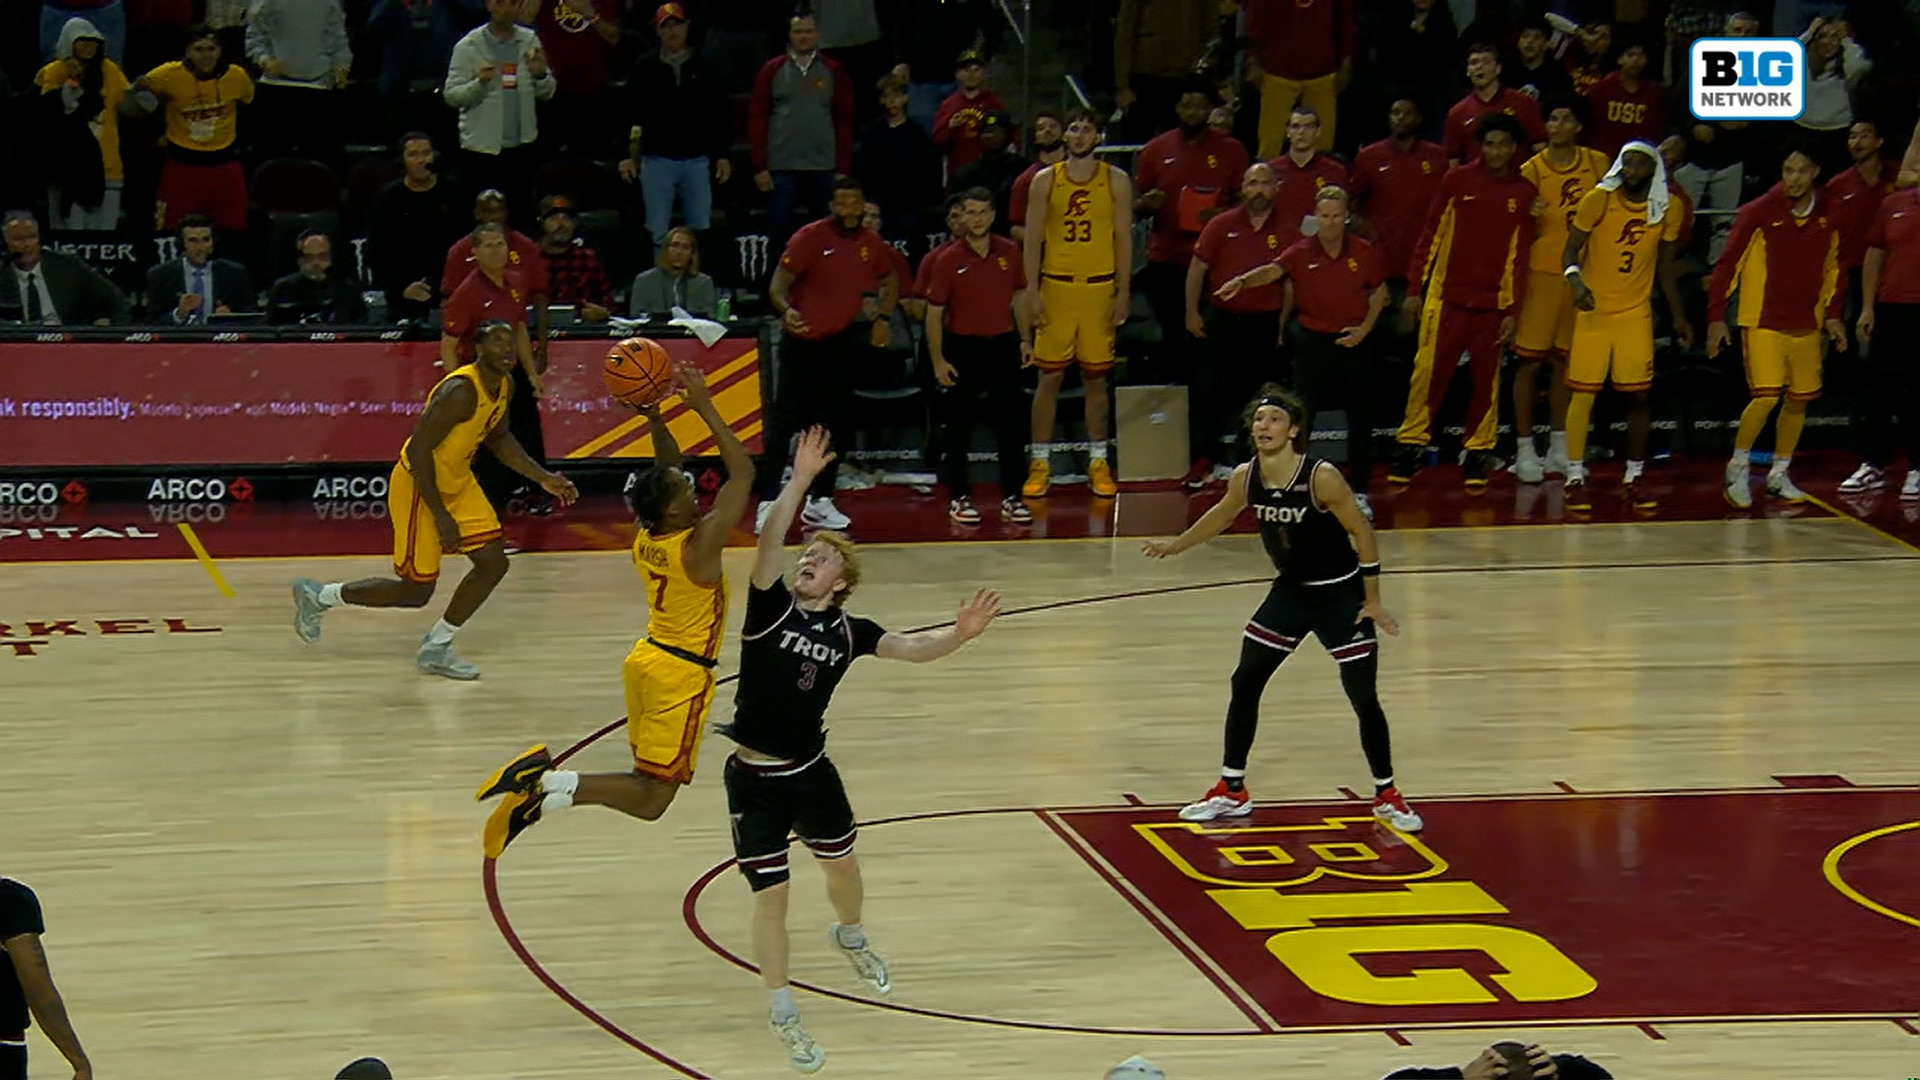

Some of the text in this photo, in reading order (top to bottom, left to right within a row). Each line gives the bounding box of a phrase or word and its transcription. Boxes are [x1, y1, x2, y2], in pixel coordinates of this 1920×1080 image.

[1607, 100, 1649, 125] USC
[1063, 220, 1092, 242] 33
[1618, 250, 1635, 274] 3
[21, 397, 135, 420] responsibly.
[147, 477, 226, 500] ARCO
[311, 475, 388, 499] ARCO
[1252, 503, 1309, 524] TROY
[647, 569, 668, 613] 7
[778, 628, 845, 667] TROY
[796, 660, 819, 692] 3
